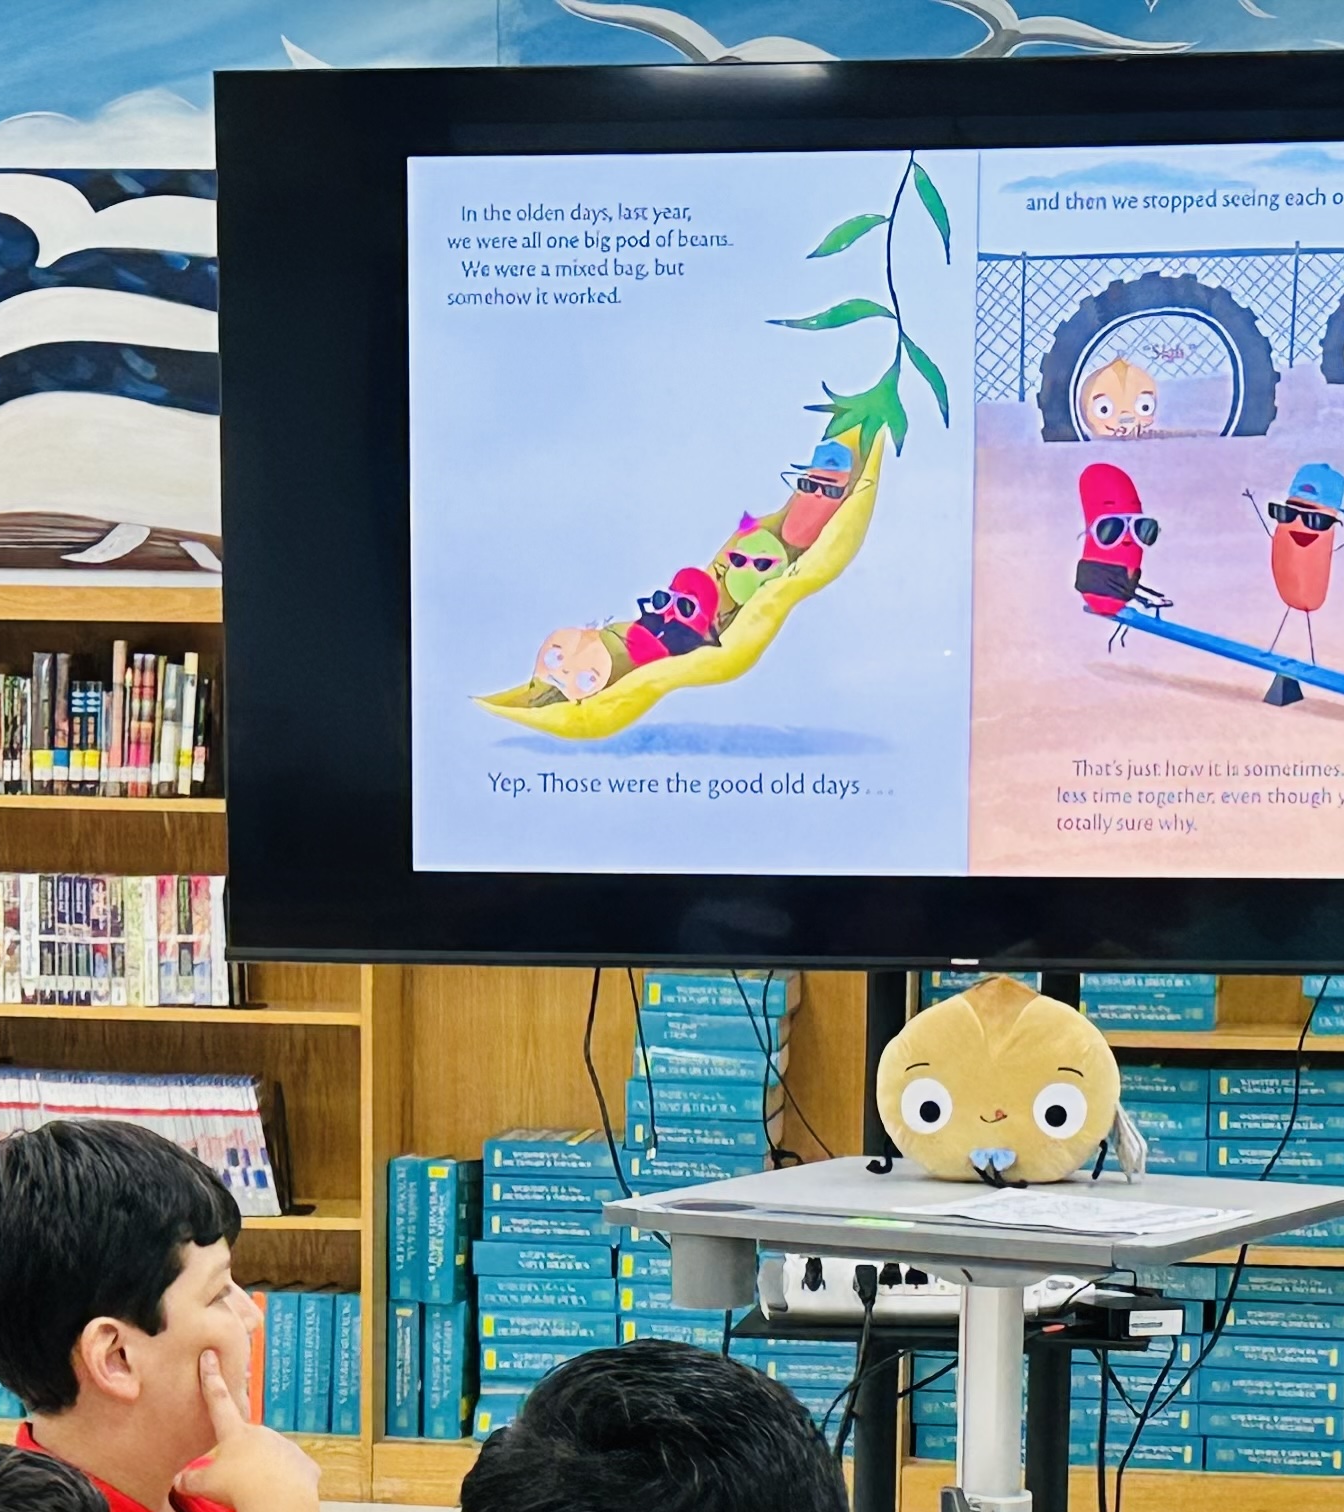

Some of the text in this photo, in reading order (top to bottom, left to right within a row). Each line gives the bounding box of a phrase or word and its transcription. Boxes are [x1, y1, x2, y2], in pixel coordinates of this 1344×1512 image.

[1025, 191, 1060, 211] and
[1065, 190, 1107, 211] then
[1112, 194, 1139, 209] we
[1142, 188, 1217, 213] stopped
[1222, 187, 1280, 212] seeing
[1285, 187, 1326, 206] each
[461, 203, 692, 225] In the olden days, last year,
[447, 229, 734, 252] we were all one big pod of beans.
[461, 260, 490, 278] We
[494, 264, 537, 278] were
[541, 264, 551, 277] a
[555, 258, 609, 277] mixed
[654, 258, 685, 276] but
[447, 287, 622, 305] somehow it worked.
[1072, 759, 1124, 777] That's
[1127, 759, 1160, 781] just
[1165, 760, 1205, 777] how
[1208, 760, 1222, 777] it
[1243, 760, 1344, 778] sometimes.
[487, 772, 532, 798] Yep.
[537, 772, 602, 794] Those
[607, 777, 659, 794] were
[666, 772, 702, 794] the
[708, 772, 763, 800] good
[770, 772, 805, 795] old
[1057, 786, 1087, 804] less
[1092, 787, 1132, 804] time
[1221, 790, 1261, 805] even
[1267, 787, 1332, 809] though
[1057, 813, 1198, 834] totally sure why.
